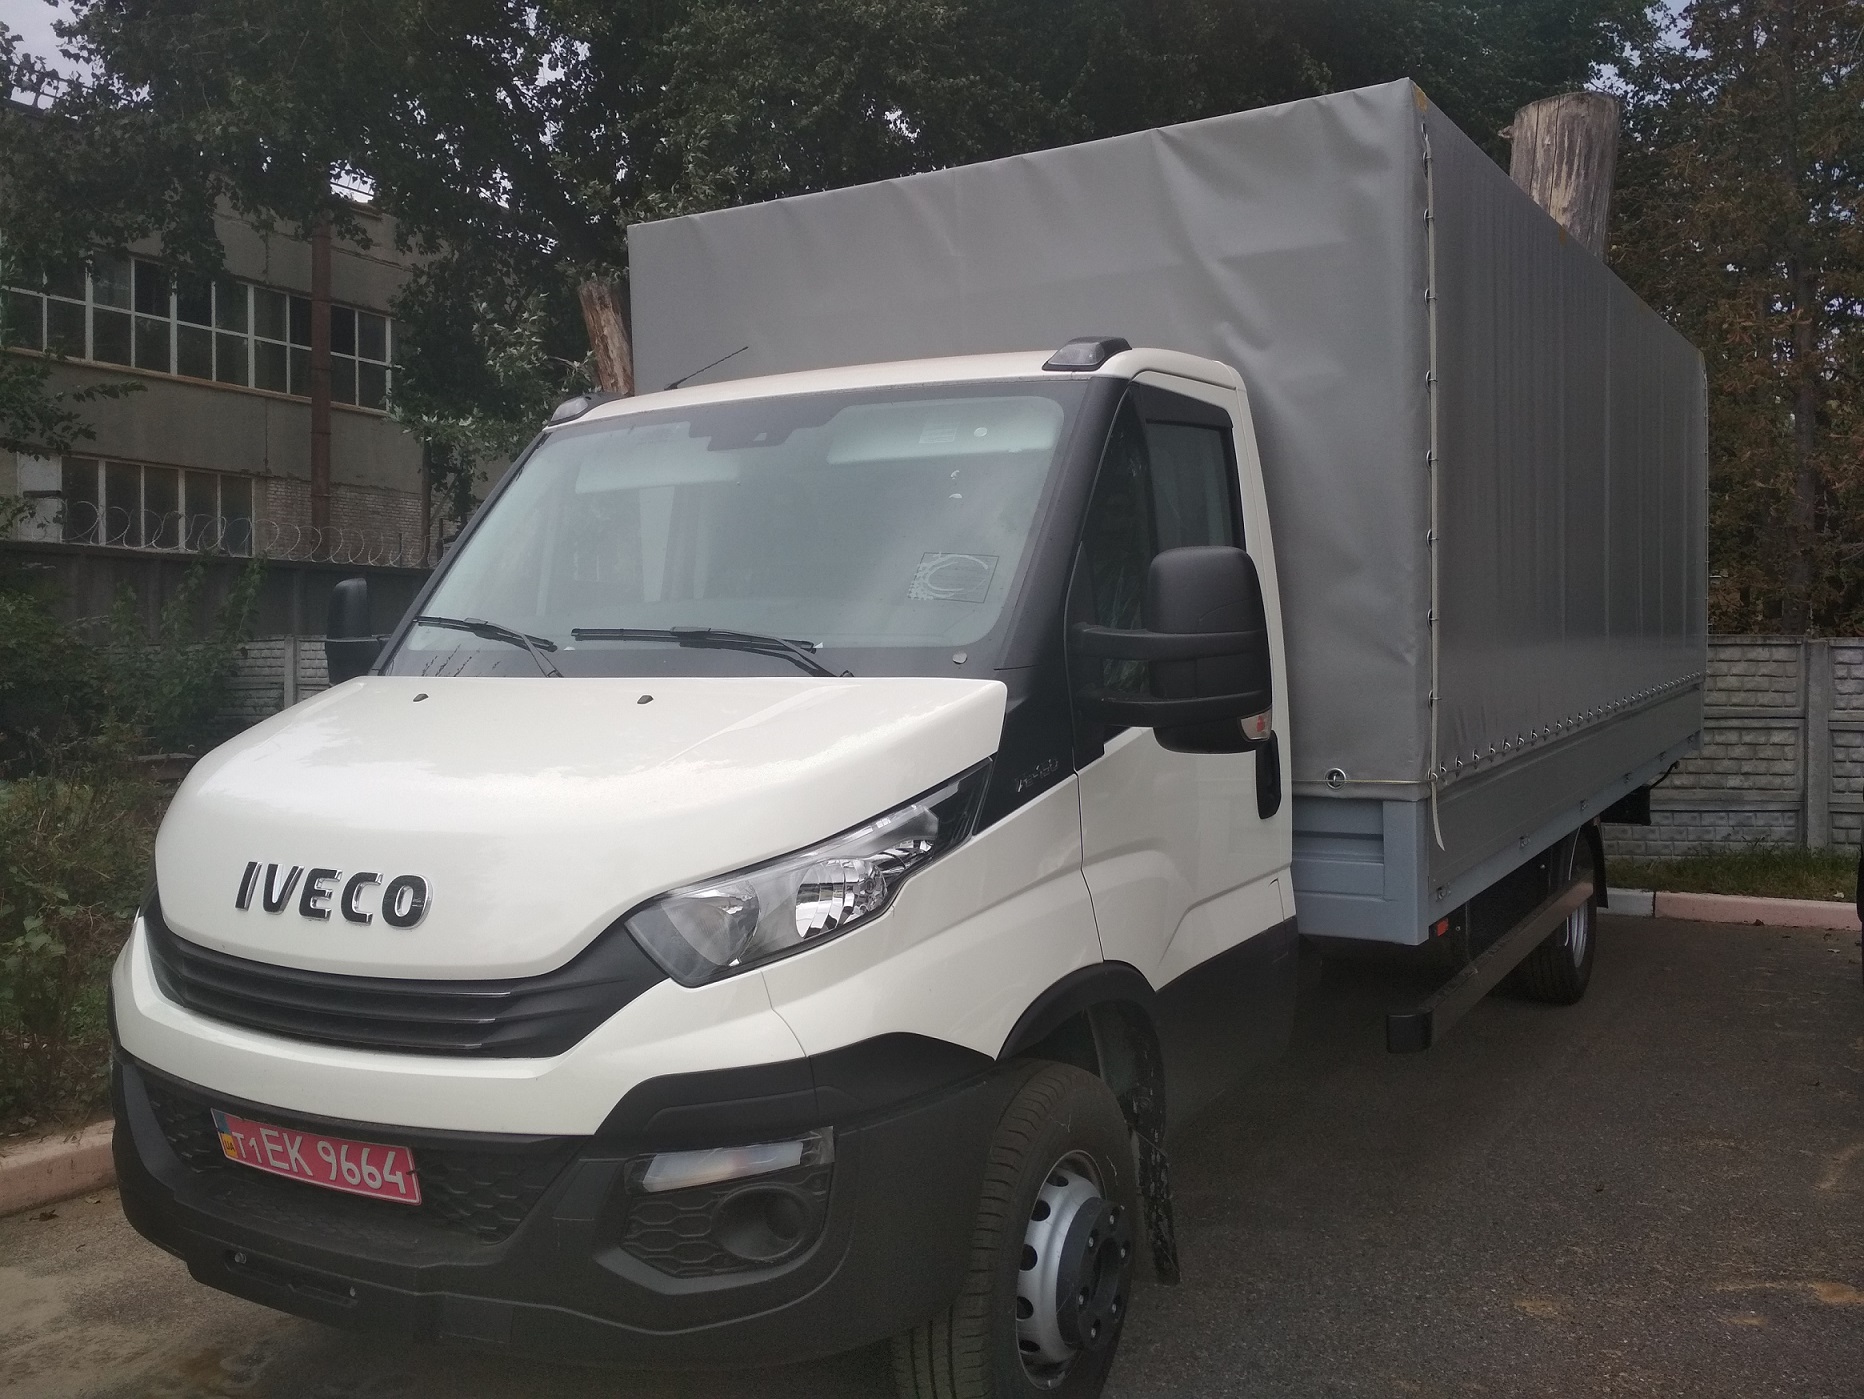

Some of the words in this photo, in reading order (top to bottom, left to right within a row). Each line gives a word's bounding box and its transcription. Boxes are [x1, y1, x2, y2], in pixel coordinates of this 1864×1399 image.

[235, 861, 433, 930] IVECO
[223, 1139, 236, 1152] UA
[317, 1140, 407, 1194] 9664
